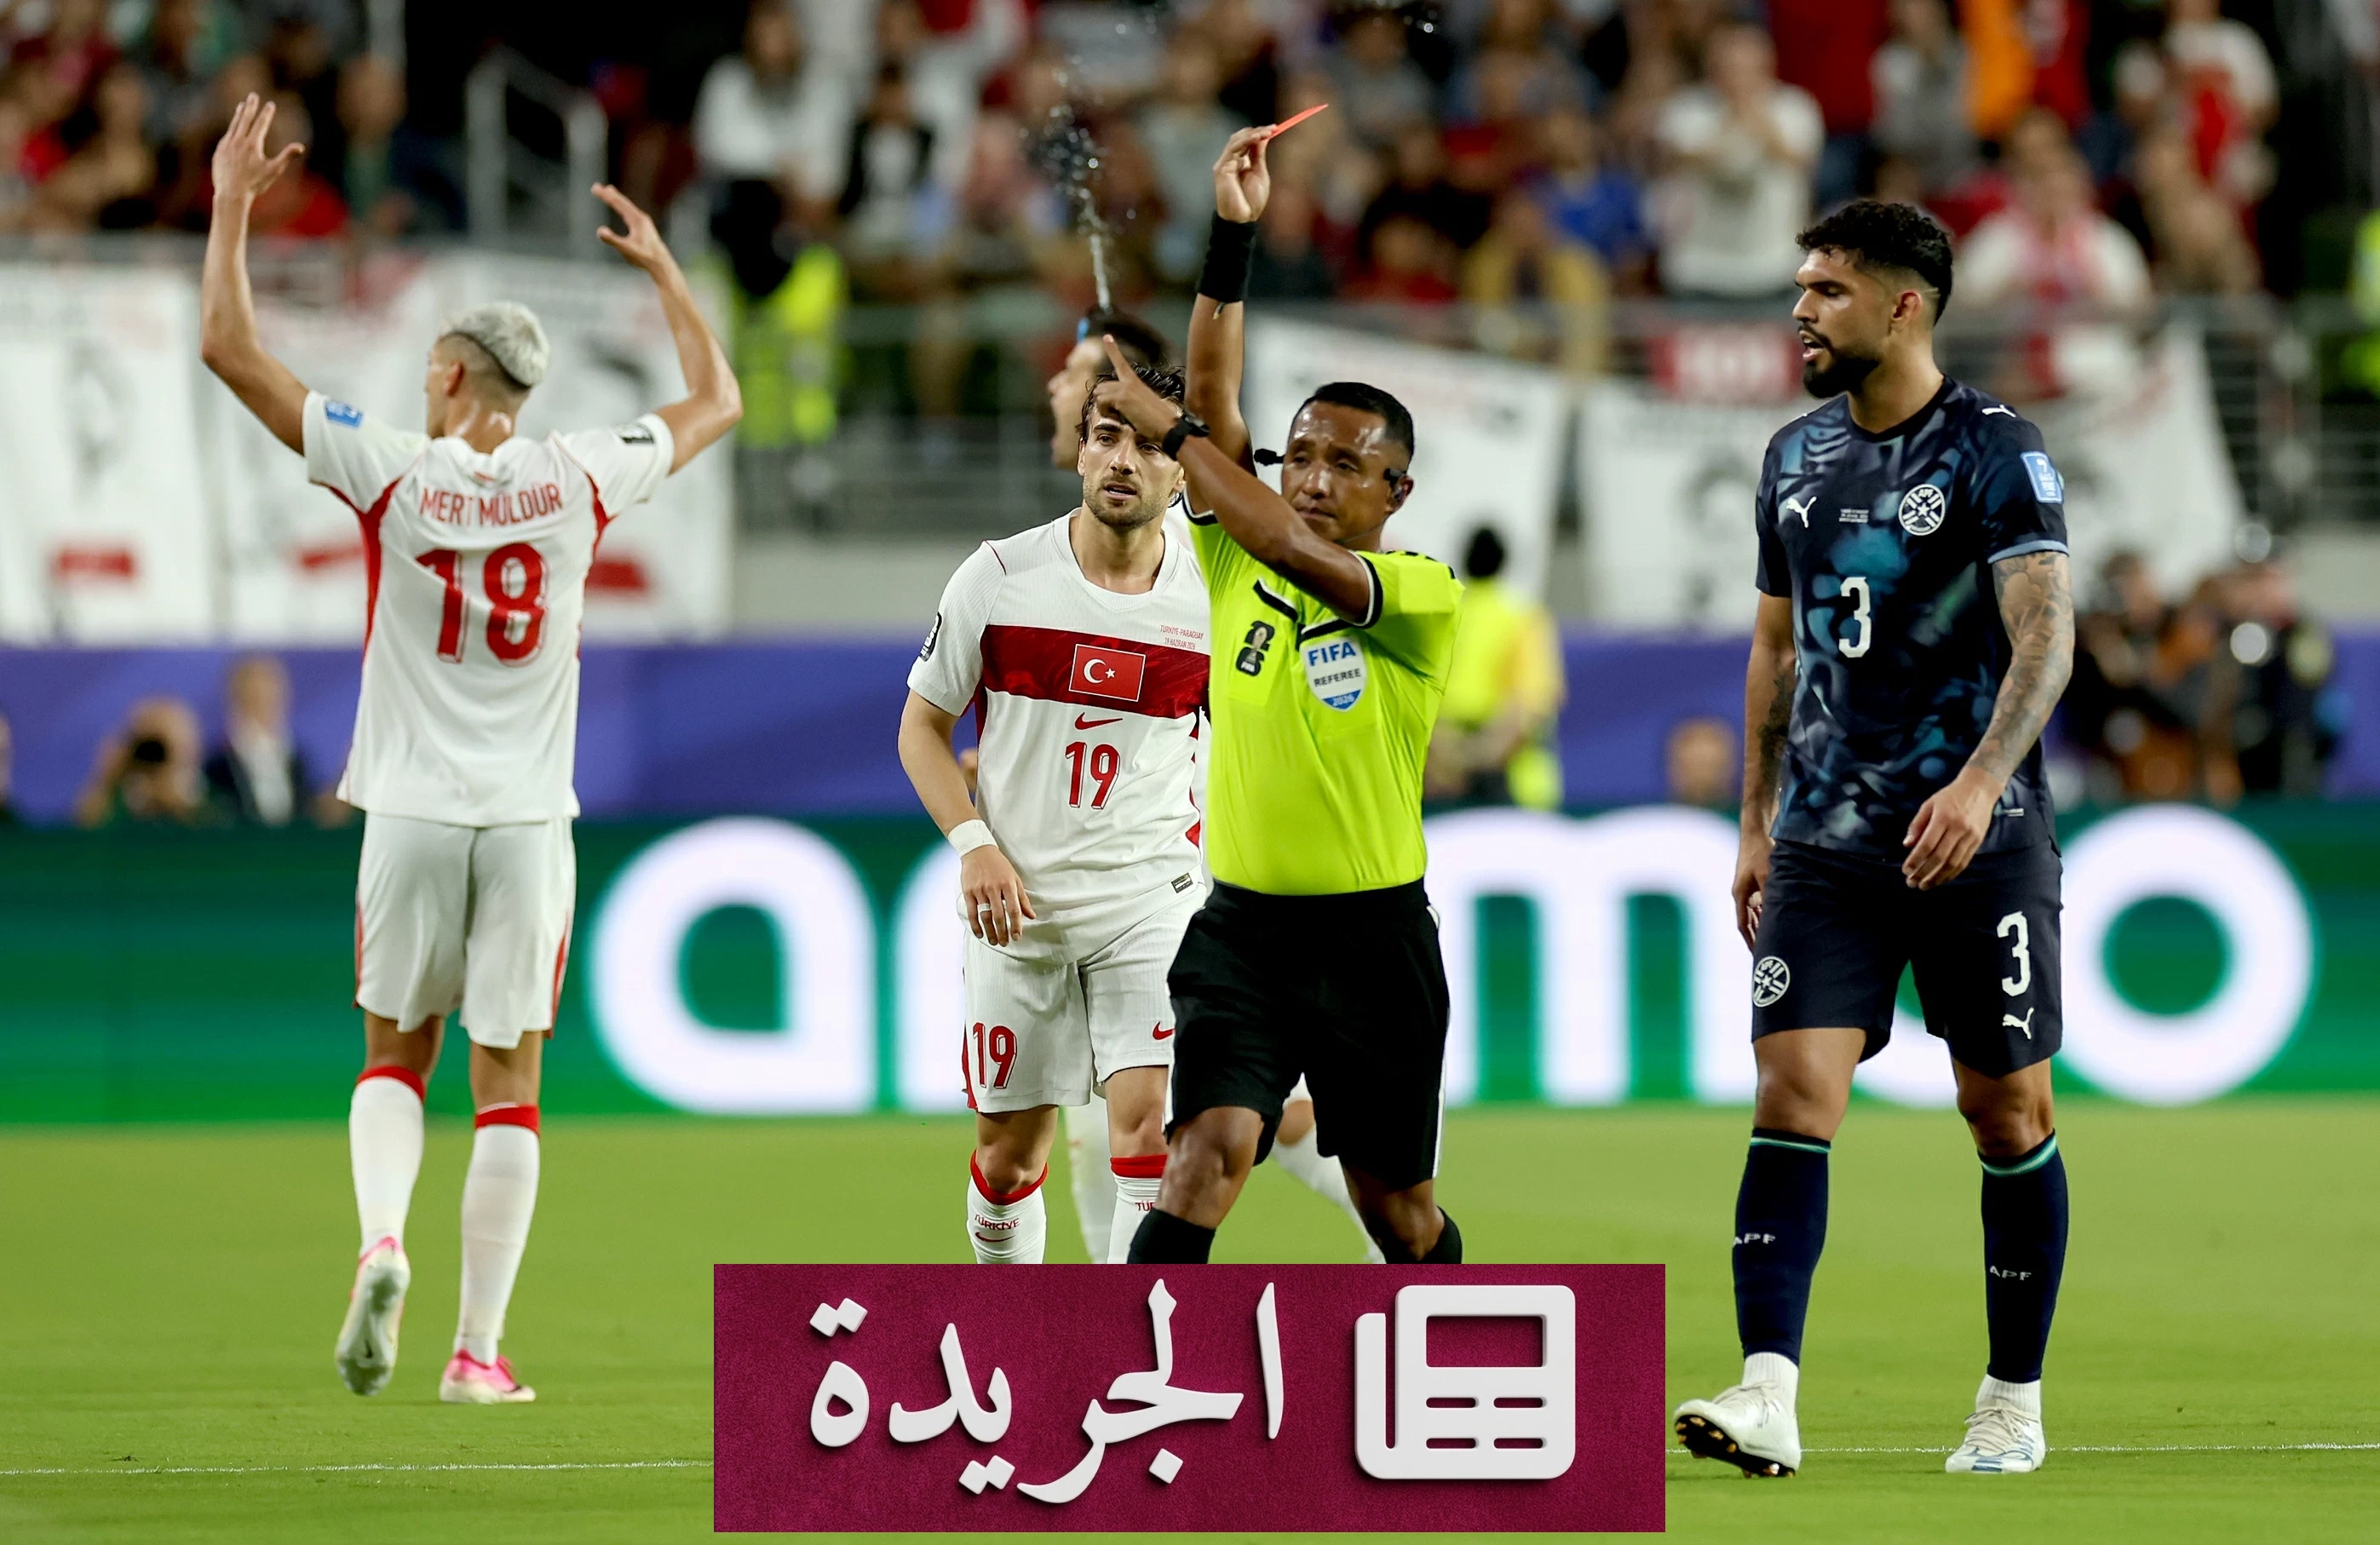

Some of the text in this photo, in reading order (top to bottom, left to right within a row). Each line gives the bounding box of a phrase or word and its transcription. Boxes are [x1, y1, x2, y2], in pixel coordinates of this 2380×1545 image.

[415, 543, 549, 668] 18
[1838, 577, 1871, 658] 3
[1308, 641, 1357, 667] FIFA
[1314, 669, 1362, 687] REFEREE
[1065, 741, 1120, 810] 19
[1997, 910, 2031, 996] 3
[973, 1022, 1018, 1090] 19
[1989, 1265, 2032, 1281] APF
